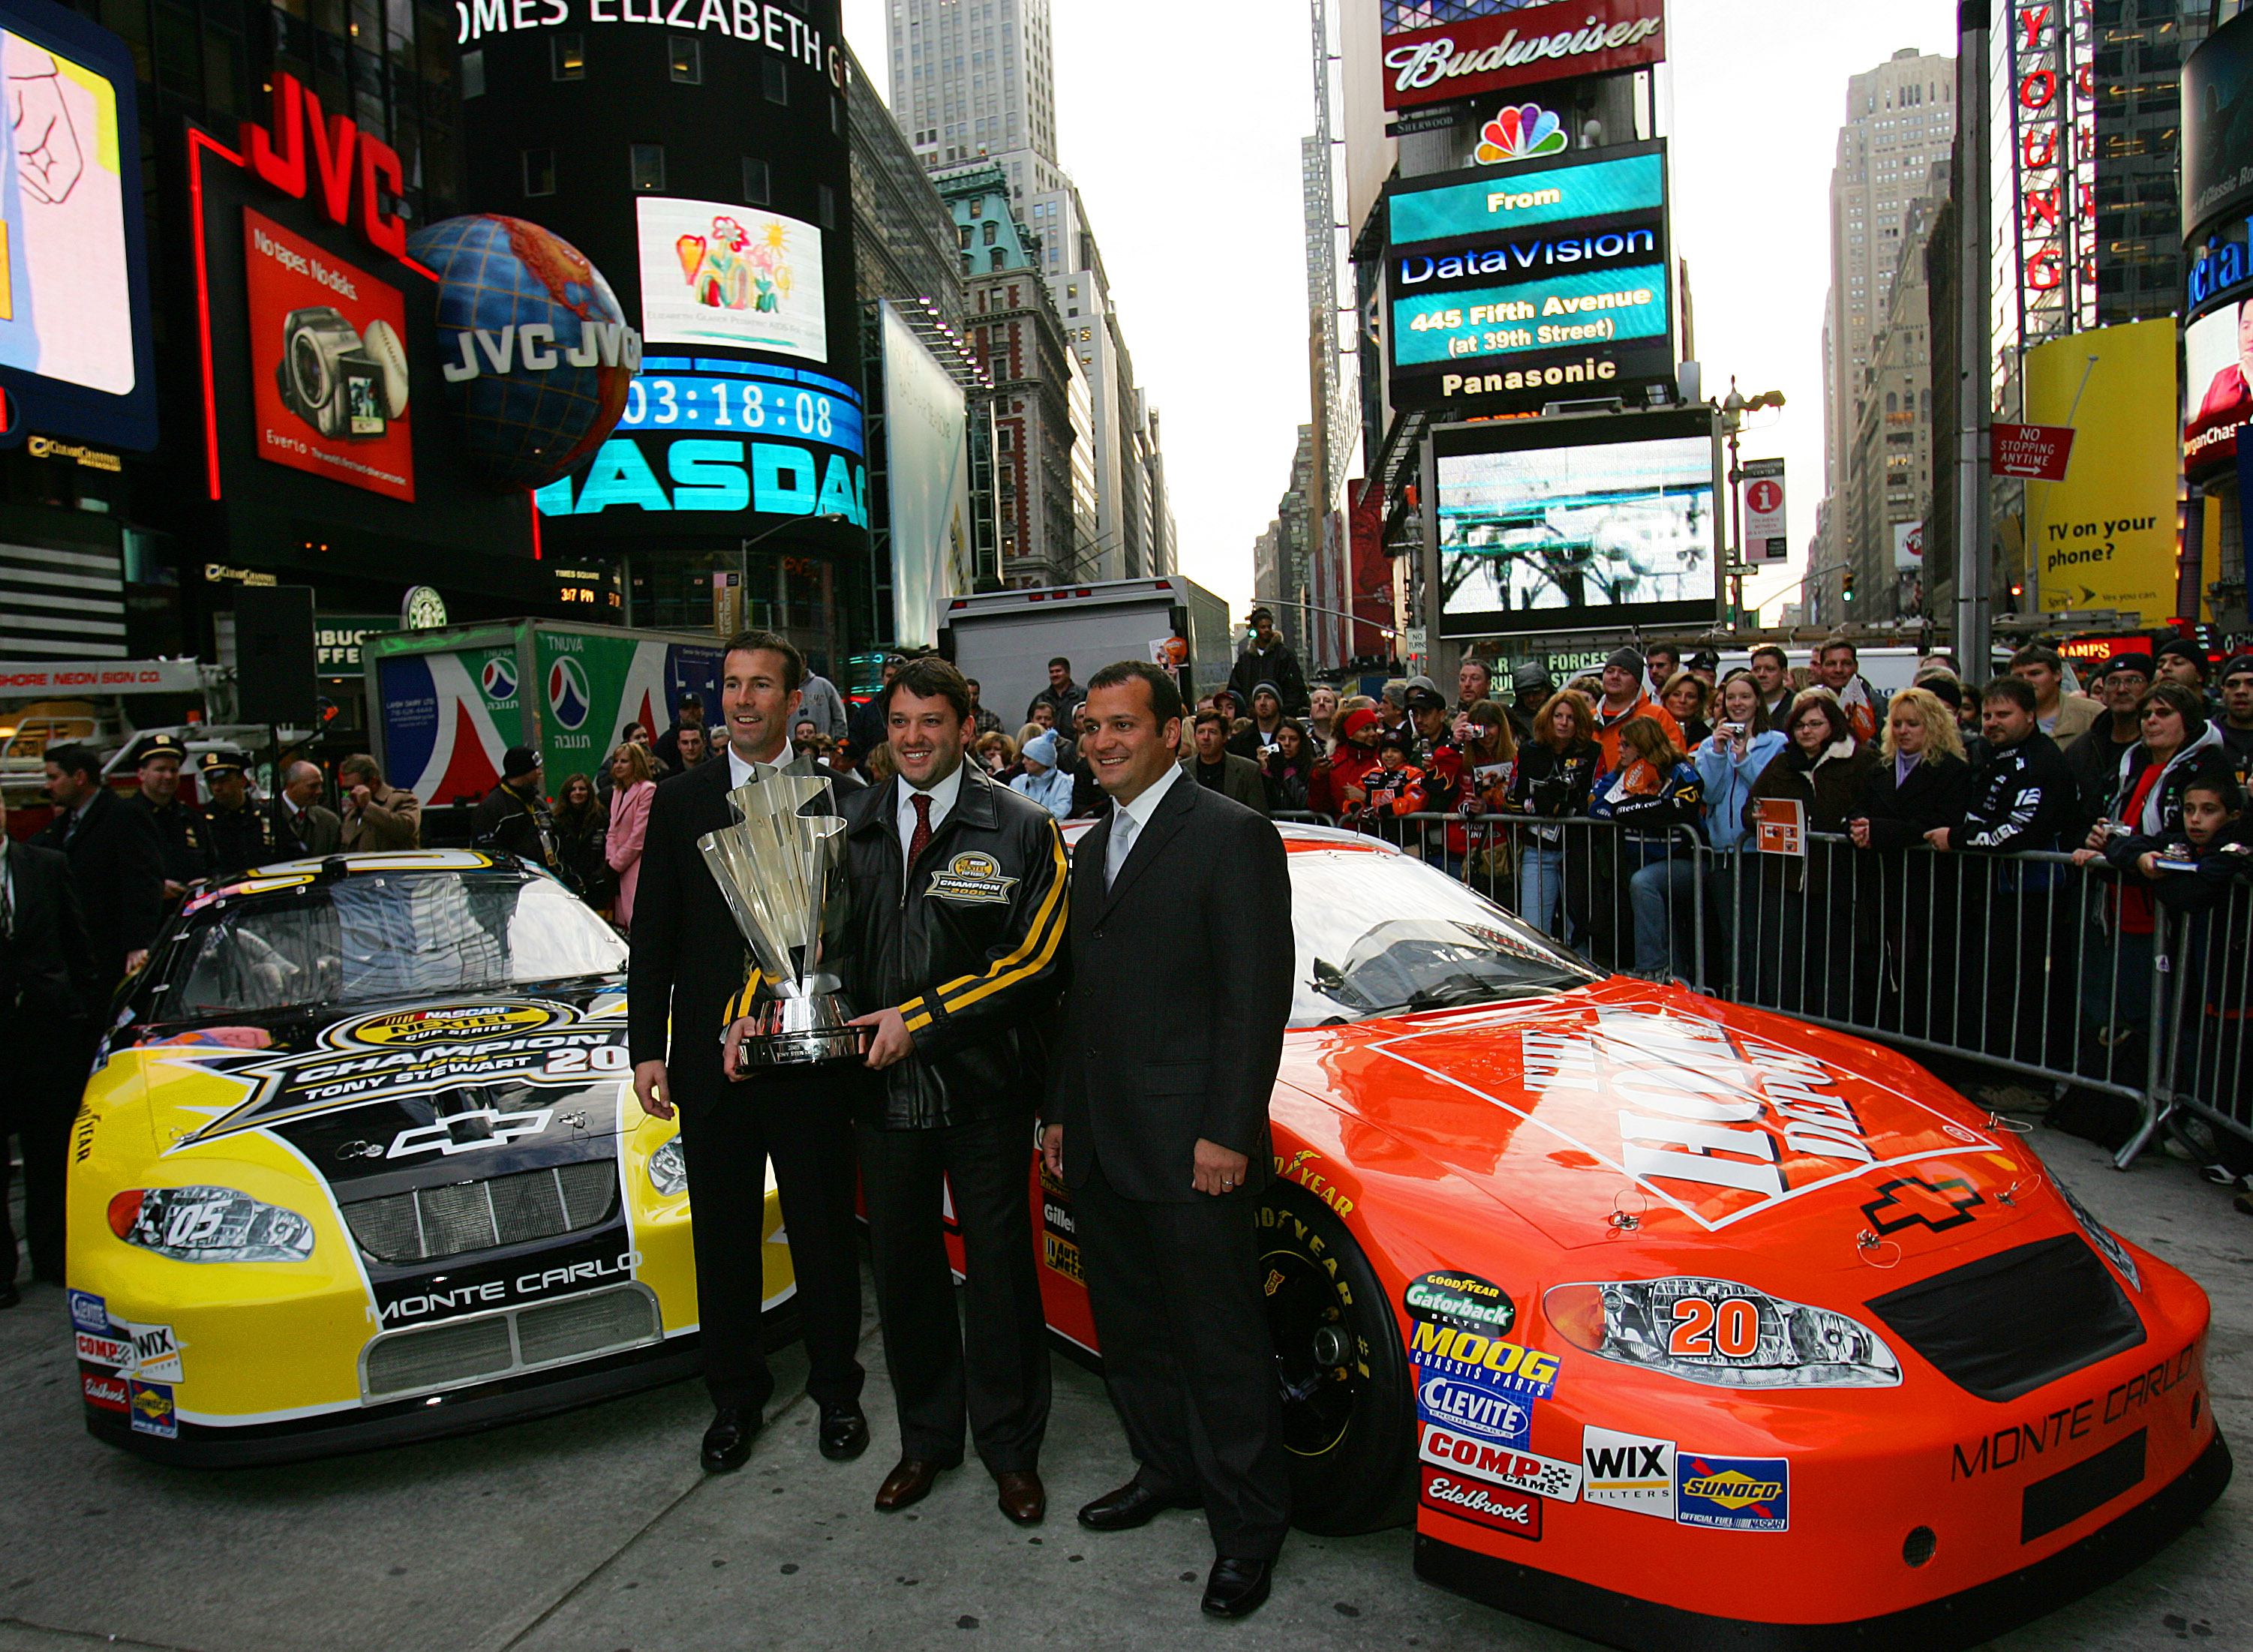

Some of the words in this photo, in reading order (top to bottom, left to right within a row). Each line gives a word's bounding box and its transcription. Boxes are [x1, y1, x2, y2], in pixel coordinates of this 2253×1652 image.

[590, 0, 822, 71] ELIZABETH
[1385, 14, 1661, 92] Budweiser
[239, 71, 407, 260] JVC
[1486, 187, 1561, 213] From
[254, 228, 274, 257] No
[1410, 308, 1462, 332] 445
[1469, 300, 1535, 326] Fifth
[1542, 288, 1652, 317] Avenue
[1447, 335, 1480, 359] (at
[1483, 328, 1531, 352] 39th
[1537, 317, 1615, 345] Street)
[443, 323, 557, 383] JVC
[1441, 357, 1616, 396] Panasonic
[622, 380, 833, 438] 03:18:08
[2000, 440, 2055, 455] STOPPING
[2019, 428, 2041, 441] NO
[2000, 452, 2050, 467] ANYTIME
[2048, 523, 2068, 541] TV
[2073, 523, 2097, 539] on
[2104, 516, 2157, 539] your
[2048, 542, 2115, 572] phone?
[317, 648, 359, 664] FFE
[546, 635, 584, 652] TNUVA
[53, 671, 98, 685] NEON
[101, 671, 135, 683] SIGN
[554, 734, 590, 749] תנובה
[2014, 787, 2041, 806] 12
[940, 879, 1000, 891] CHAMPION
[391, 1016, 519, 1035] NEXTEL
[425, 1007, 506, 1020] NASCAR
[405, 1029, 446, 1041] CUP
[448, 1024, 513, 1035] SERIES
[295, 1033, 610, 1083] CHAMPION
[304, 1076, 381, 1101] TONY
[394, 1056, 532, 1083] STEWART
[545, 1045, 630, 1074] 20
[365, 1281, 506, 1323] MONTE
[516, 1250, 643, 1294] CARLO
[1427, 1275, 1500, 1298] GOODYEAR
[1407, 1284, 1510, 1326] Gatorback
[1431, 1313, 1480, 1329] BELTS
[1668, 1296, 1760, 1359] 20
[79, 1335, 119, 1359] COMP
[132, 1328, 174, 1359] WIX
[1410, 1321, 1561, 1384] MOOG
[1415, 1351, 1482, 1380] CHASSIS
[1492, 1371, 1546, 1397] PARTS
[1425, 1377, 1521, 1431] CLEVITE
[1951, 1398, 2094, 1482] MONTE
[2104, 1344, 2194, 1425] CARLO
[1431, 1410, 1471, 1426] ENGINE
[1476, 1422, 1513, 1438] PARTS
[1428, 1432, 1541, 1476] COMP
[1585, 1444, 1667, 1479] WIX
[1502, 1473, 1560, 1494] CAMS
[1588, 1489, 1669, 1499] FILTERS
[1688, 1480, 1778, 1499] SUNOCO
[1428, 1478, 1529, 1524] Edelbrock
[1680, 1512, 1713, 1524] OFFICIAL
[1715, 1516, 1733, 1528] FUEL
[1747, 1518, 1785, 1529] NASCAR
